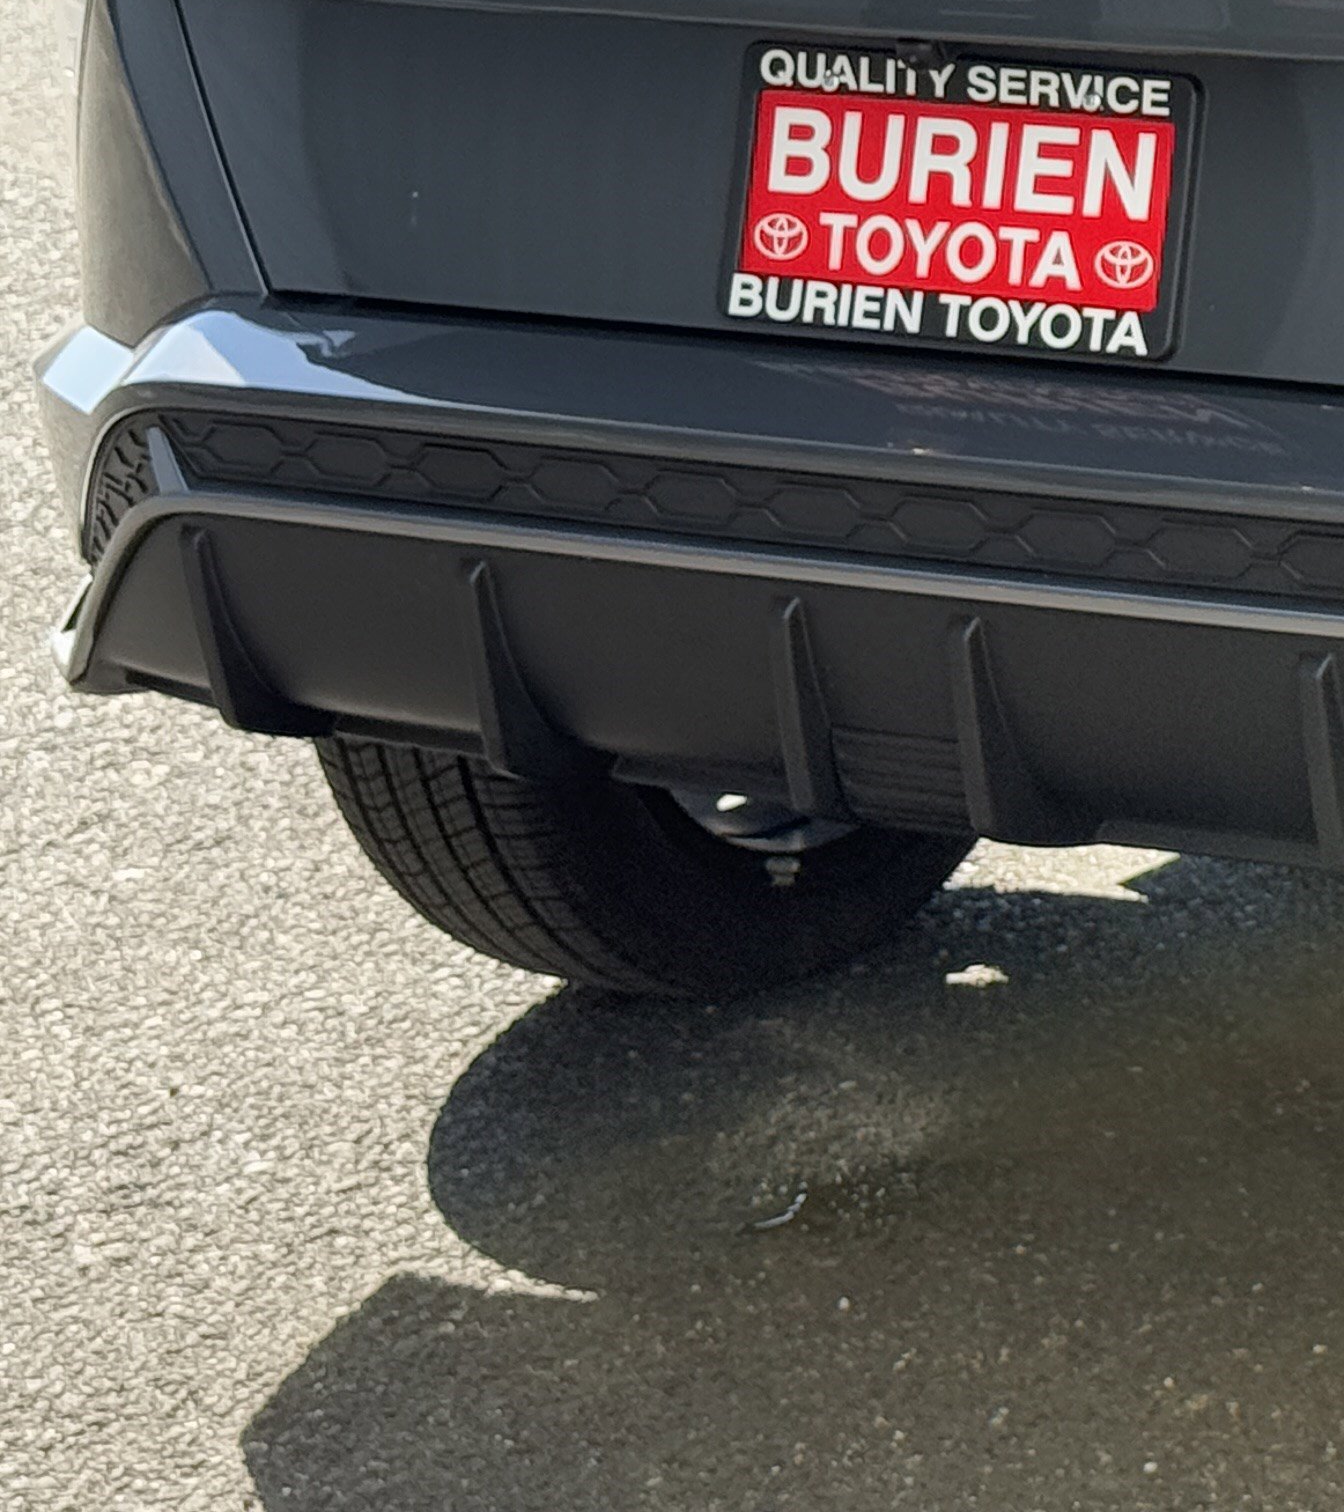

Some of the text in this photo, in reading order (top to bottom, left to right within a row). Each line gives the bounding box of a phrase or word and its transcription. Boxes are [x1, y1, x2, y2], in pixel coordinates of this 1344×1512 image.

[759, 49, 1172, 117] QUALITY SERVICE
[767, 106, 1158, 222] BURIEN
[818, 211, 1083, 291] TOYOTA
[727, 272, 1149, 357] BURIEN TOYOTA
